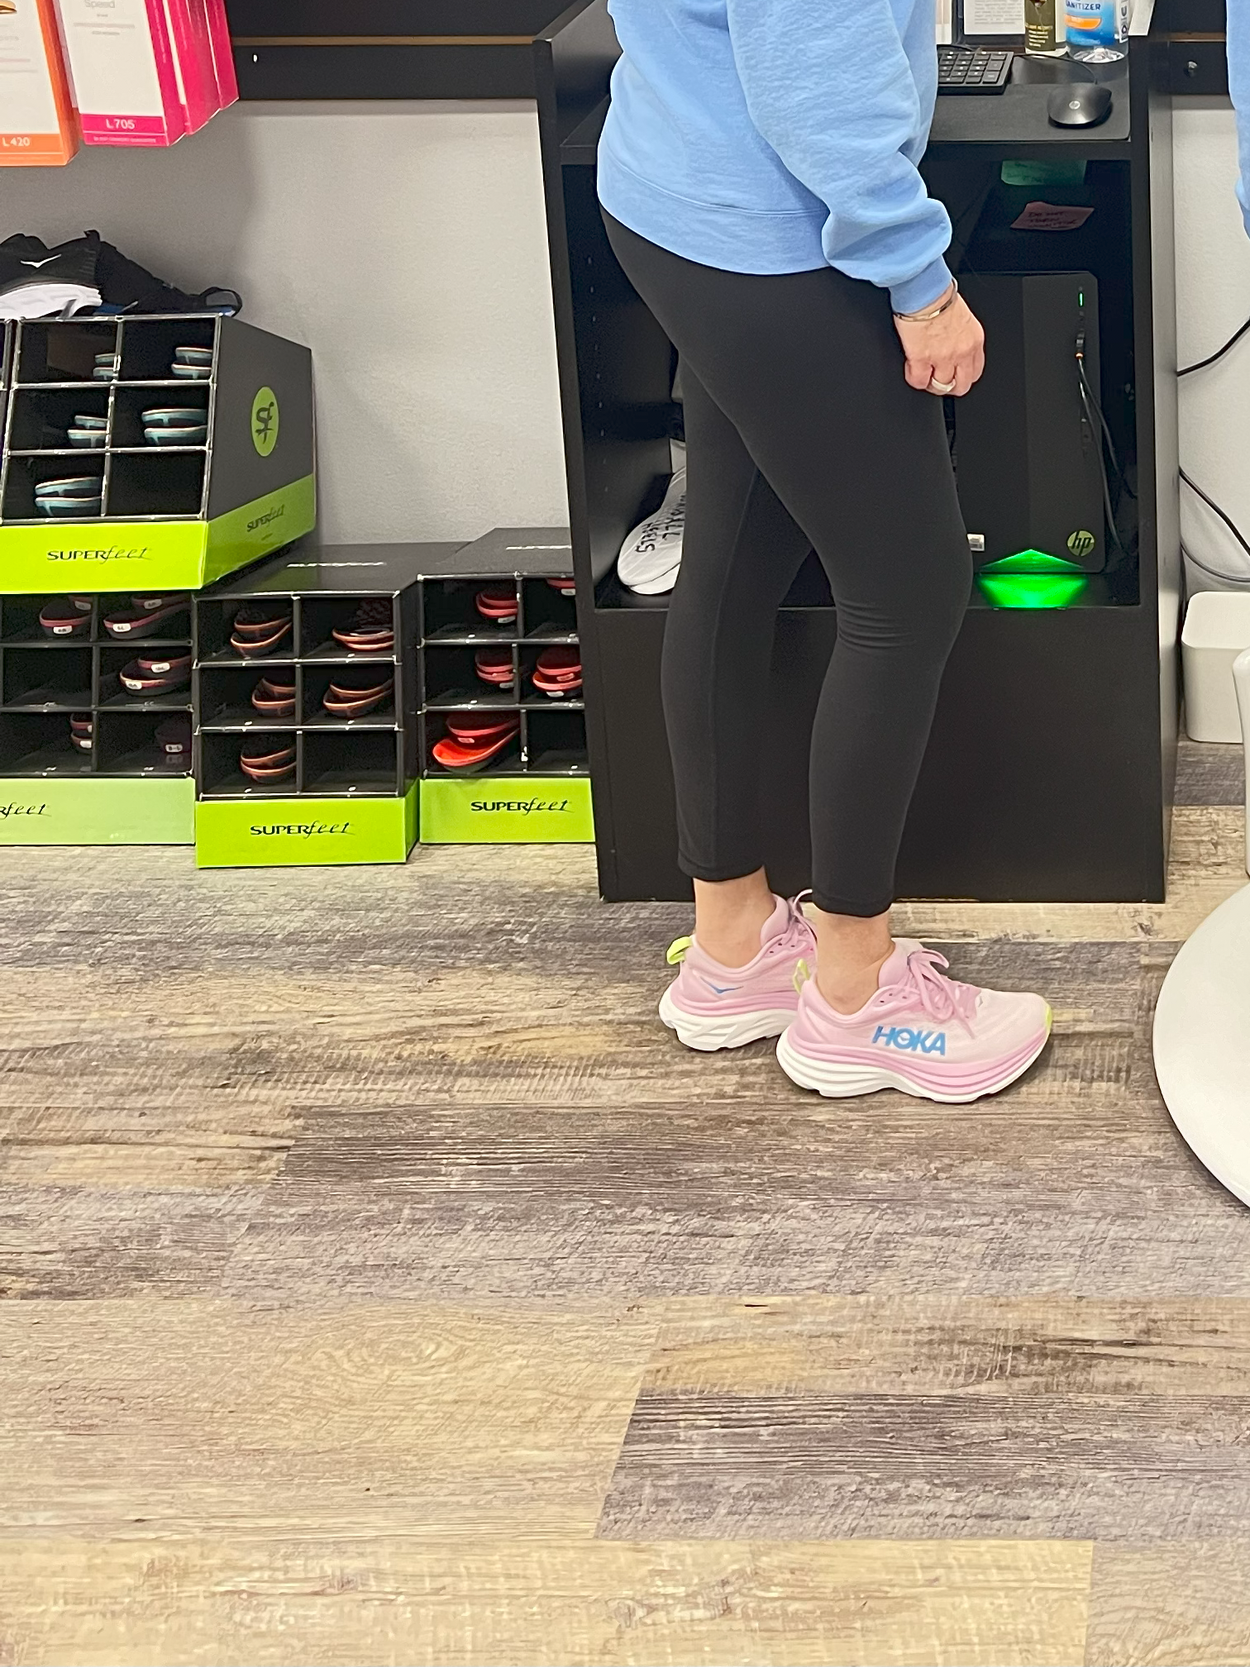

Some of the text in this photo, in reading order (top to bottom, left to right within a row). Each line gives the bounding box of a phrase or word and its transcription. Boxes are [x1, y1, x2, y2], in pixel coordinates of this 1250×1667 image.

[1070, 530, 1092, 556] hp
[47, 545, 153, 565] SUPERfeet
[471, 797, 573, 816] SUPERfeet
[250, 820, 354, 839] SUPERfeet
[872, 1026, 946, 1056] HOKA
